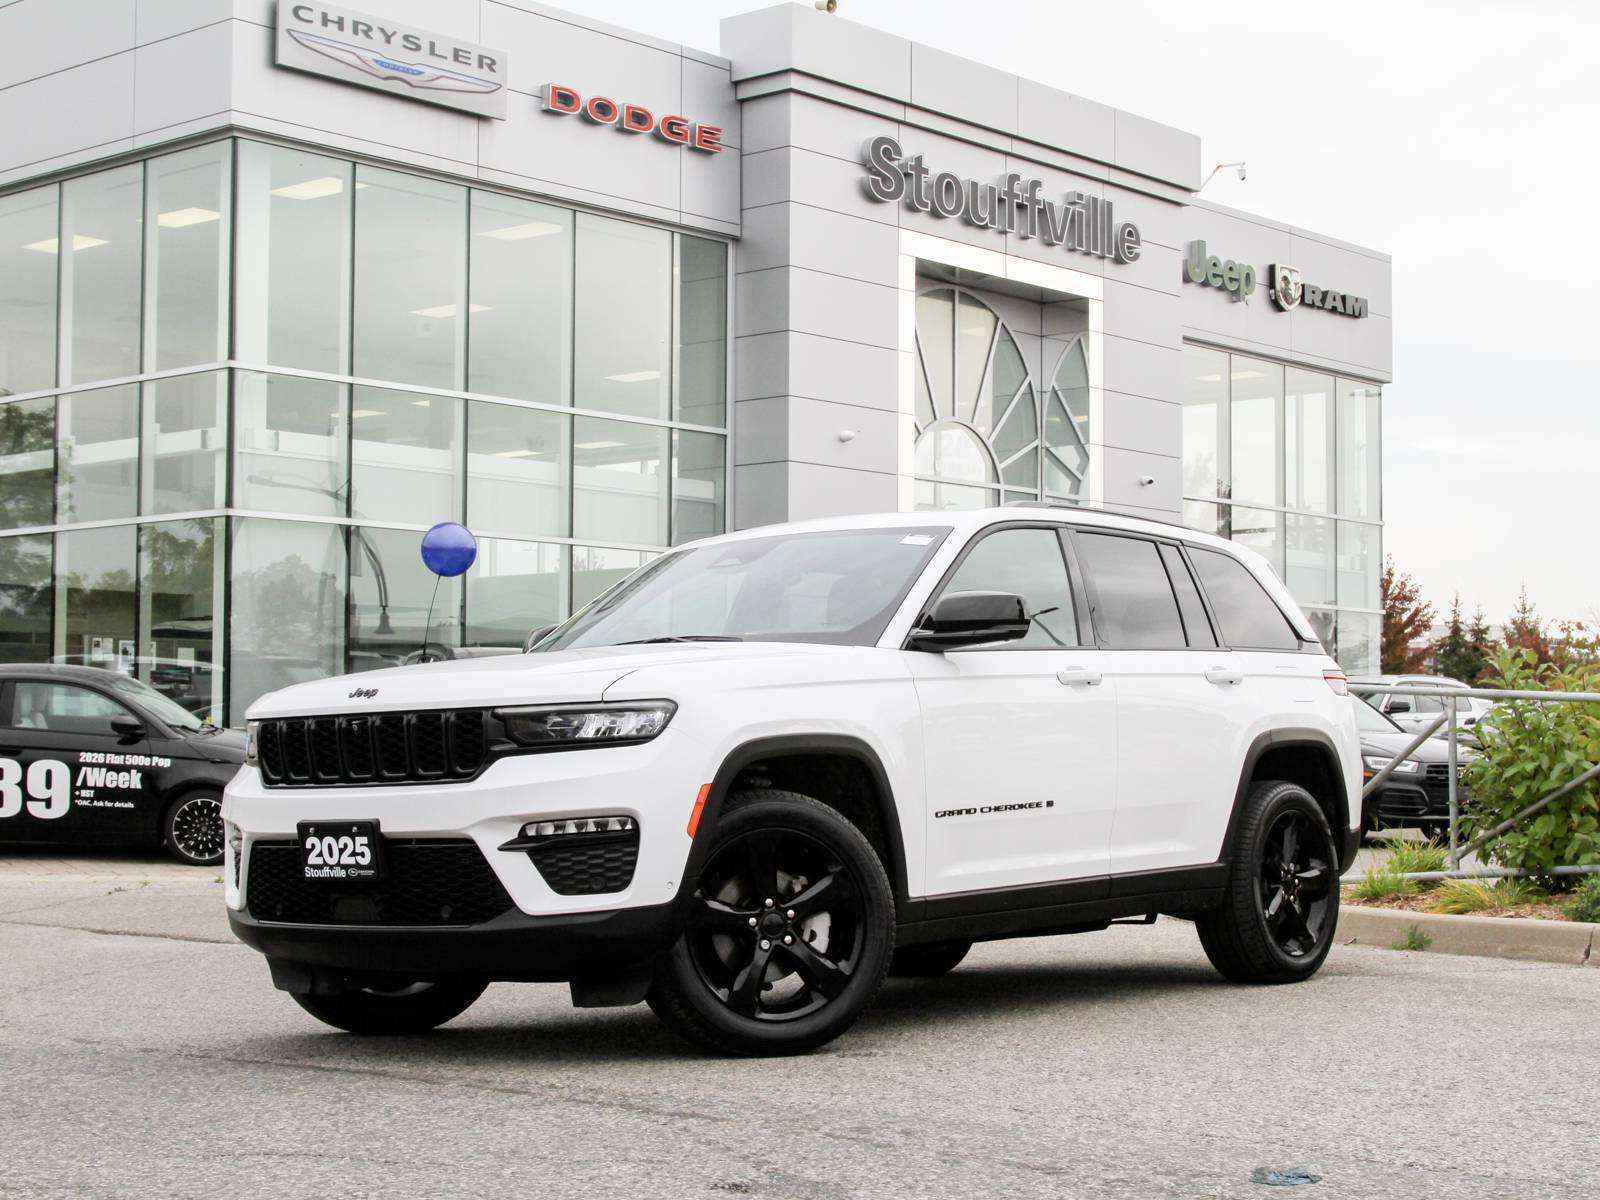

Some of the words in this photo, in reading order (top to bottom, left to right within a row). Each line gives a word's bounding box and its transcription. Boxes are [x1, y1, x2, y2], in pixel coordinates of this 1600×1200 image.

[292, 5, 497, 74] CHRYSLER
[543, 83, 722, 153] DODGE
[864, 136, 1141, 264] Stouffville
[1184, 240, 1256, 302] Jeep
[1303, 283, 1368, 318] RAM
[349, 688, 379, 699] Jeep
[106, 753, 124, 765] Fiat
[76, 766, 142, 789] /Week
[935, 808, 977, 818] GRAND
[980, 801, 1043, 814] CHEROKEE
[305, 836, 371, 865] 2025
[305, 867, 346, 878] Stouffville
